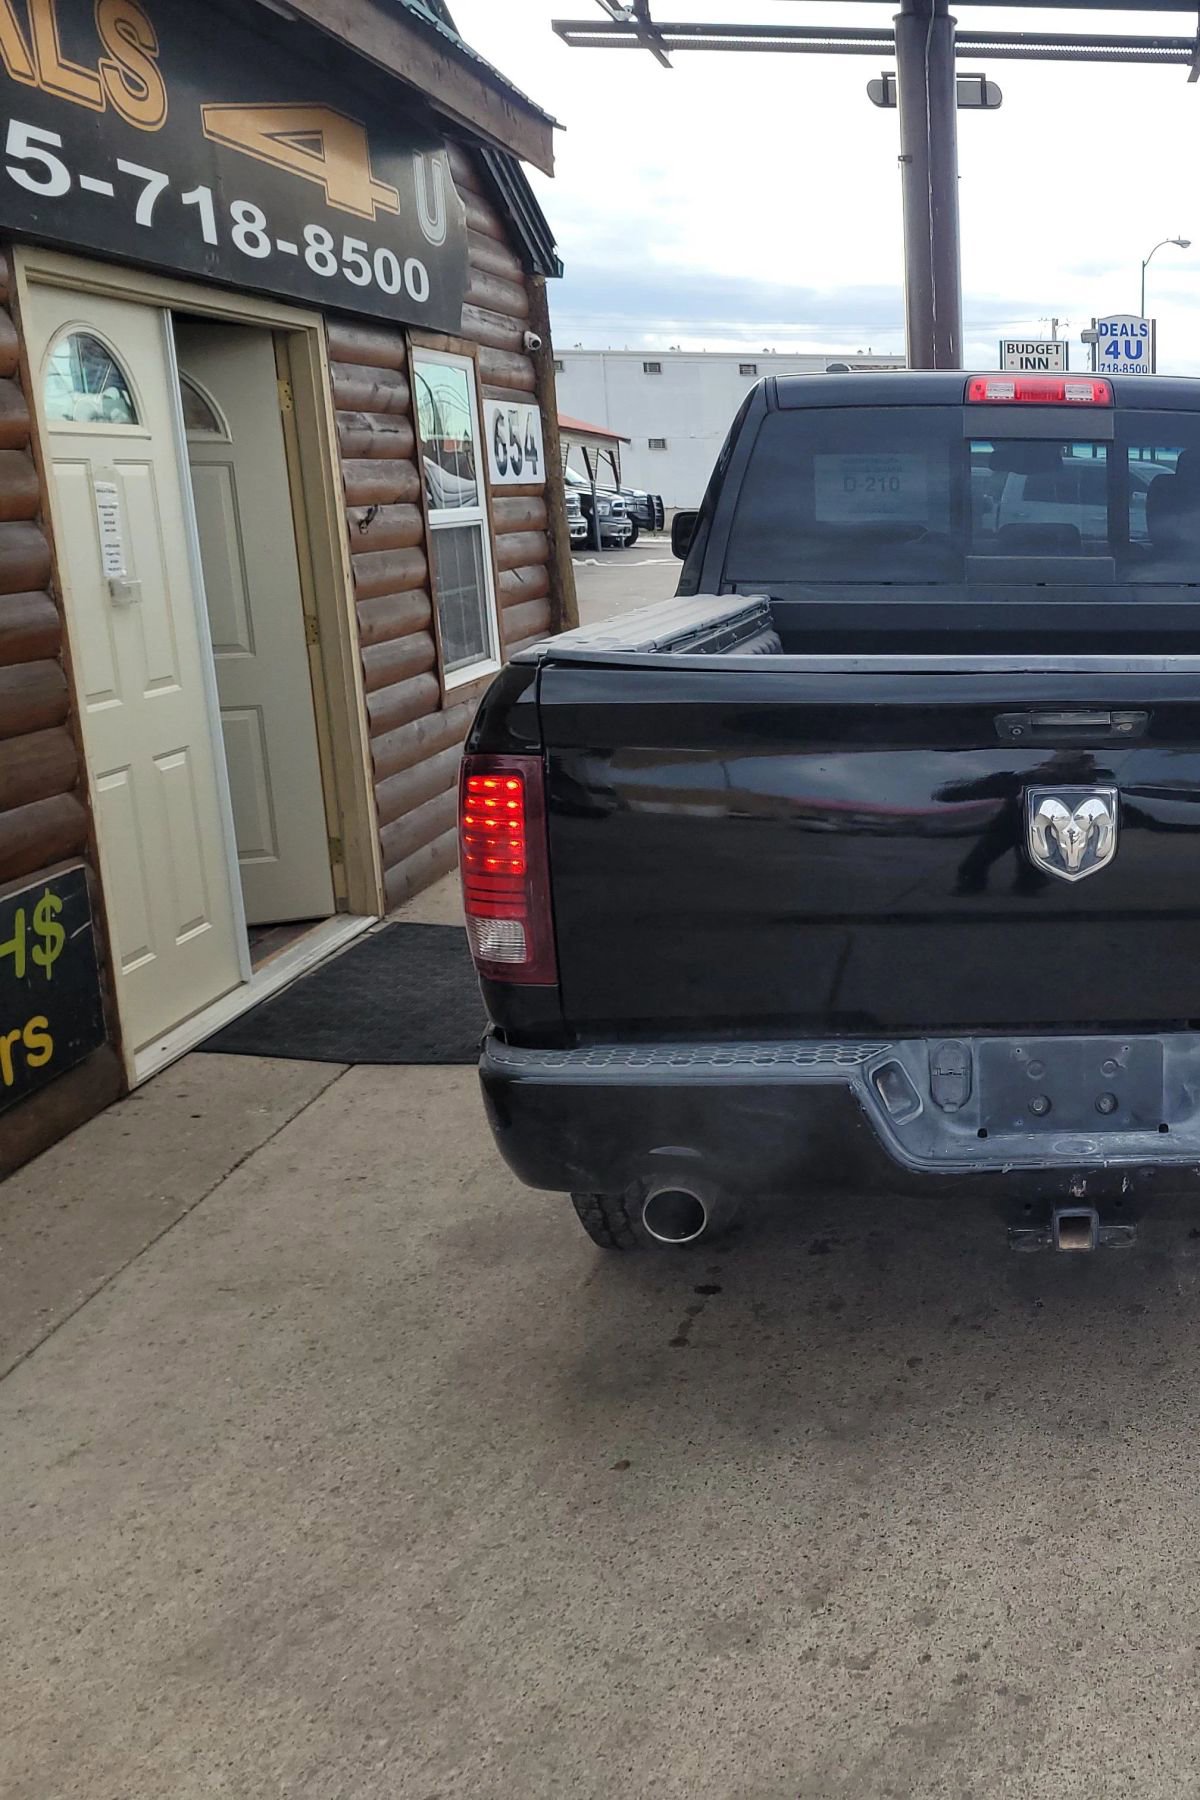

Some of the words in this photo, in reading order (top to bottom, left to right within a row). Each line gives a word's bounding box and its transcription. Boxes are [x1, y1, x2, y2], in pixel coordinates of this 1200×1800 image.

[200, 101, 400, 221] 4
[411, 147, 449, 248] U
[5, 118, 430, 303] 5-718-8500
[1100, 323, 1148, 337] DEALS
[1007, 343, 1061, 355] BUDGET
[1020, 357, 1049, 370] INN
[493, 407, 539, 477] 654
[843, 476, 900, 492] D-210
